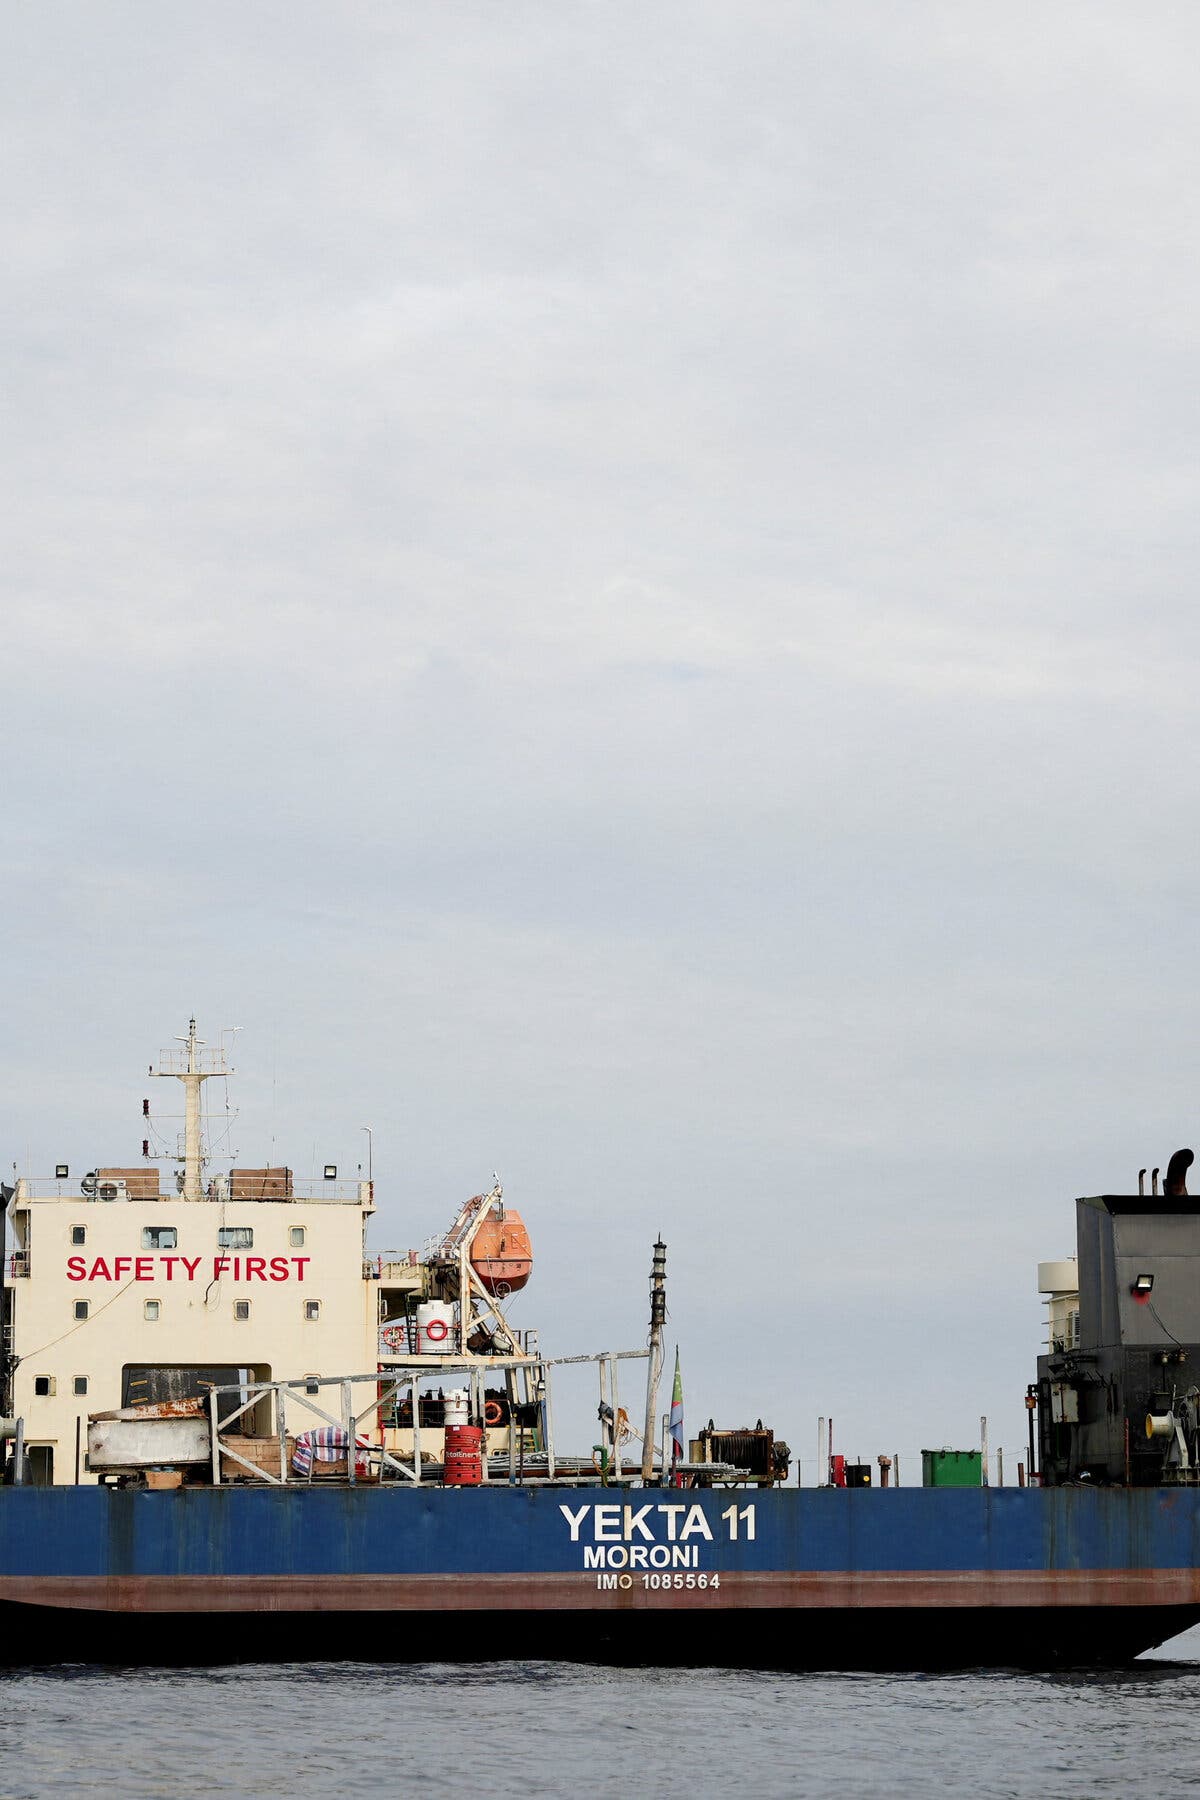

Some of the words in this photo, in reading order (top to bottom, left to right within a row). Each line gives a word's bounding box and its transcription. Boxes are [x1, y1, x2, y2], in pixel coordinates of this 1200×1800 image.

[66, 1257, 202, 1281] SAFETY
[213, 1257, 311, 1281] FIRST
[559, 1504, 713, 1541] YEKTA
[721, 1504, 755, 1541] 11
[583, 1545, 699, 1568] MORONI
[597, 1574, 633, 1590] IMO
[642, 1573, 720, 1590] 1085564
